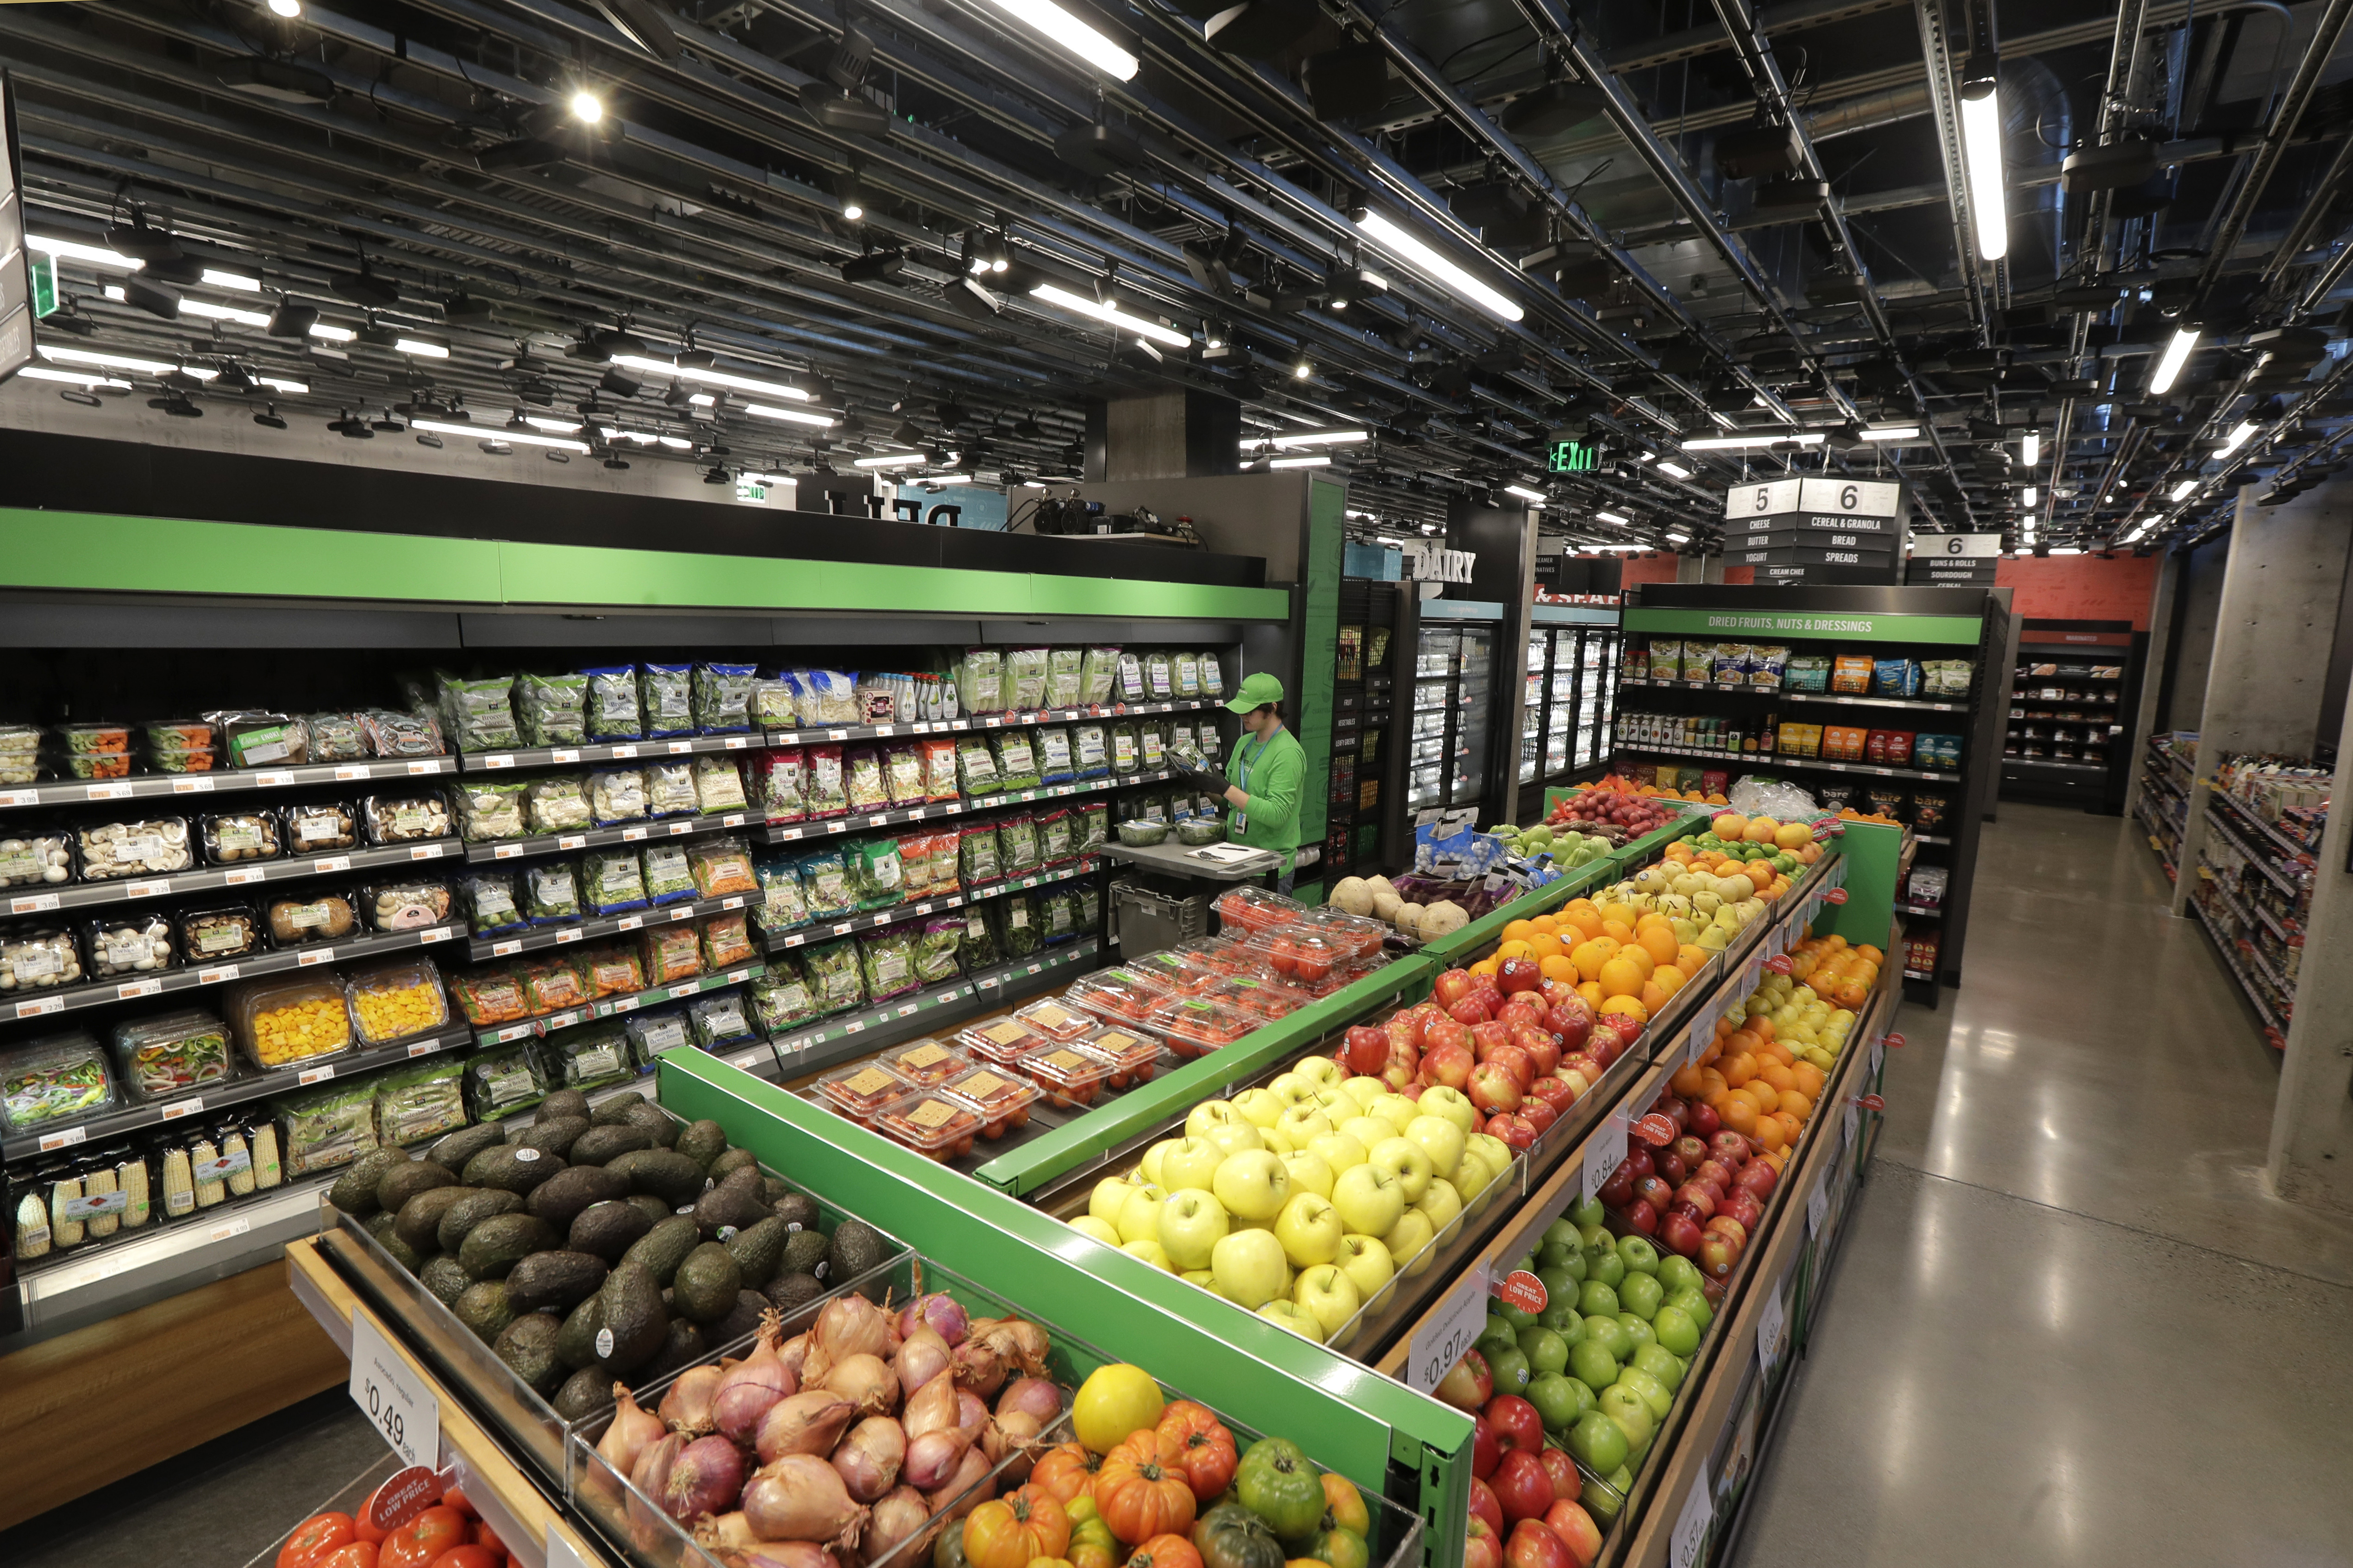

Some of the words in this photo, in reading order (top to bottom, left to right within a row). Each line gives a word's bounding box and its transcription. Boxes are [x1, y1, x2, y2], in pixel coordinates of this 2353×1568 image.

[1756, 487, 1768, 511] 5
[1840, 485, 1858, 509] 6
[1750, 519, 1770, 530] CHEESE
[1812, 517, 1838, 528] CEREAL
[1840, 519, 1846, 528] &
[1847, 519, 1880, 530] GRANOLA
[1748, 536, 1768, 546] BUTTER
[1832, 536, 1856, 546] BREAD
[1948, 538, 1962, 554] 6
[1746, 553, 1767, 562] YOGURT
[1826, 553, 1858, 563] SPREADS
[1413, 545, 1476, 584] DAIRY
[1709, 616, 1737, 628] DRIED
[1739, 617, 1774, 630] FRUITS,
[1777, 618, 1802, 630] NUTS
[1804, 619, 1812, 630] &
[1814, 620, 1872, 633] DRESSINGS
[481, 712, 507, 721] Broccoli
[1338, 718, 1356, 727] VEGETABLES
[260, 731, 280, 741] ENOKI
[1335, 739, 1345, 747] LEAFY
[1345, 737, 1355, 746] GREENS
[1823, 789, 1848, 799] bare
[1871, 791, 1902, 803] bare
[1915, 795, 1946, 807] bare
[1643, 1123, 1654, 1132] LOW
[1654, 1129, 1670, 1140] PRICE
[1650, 1122, 1666, 1132] GREAT
[1516, 1282, 1537, 1294] GREAT
[1509, 1284, 1523, 1296] LOW
[1524, 1291, 1542, 1305] PRICE
[402, 1441, 415, 1464] each
[387, 1479, 418, 1505] GREAT
[379, 1499, 401, 1522] LOW
[402, 1479, 431, 1504] PRICE
